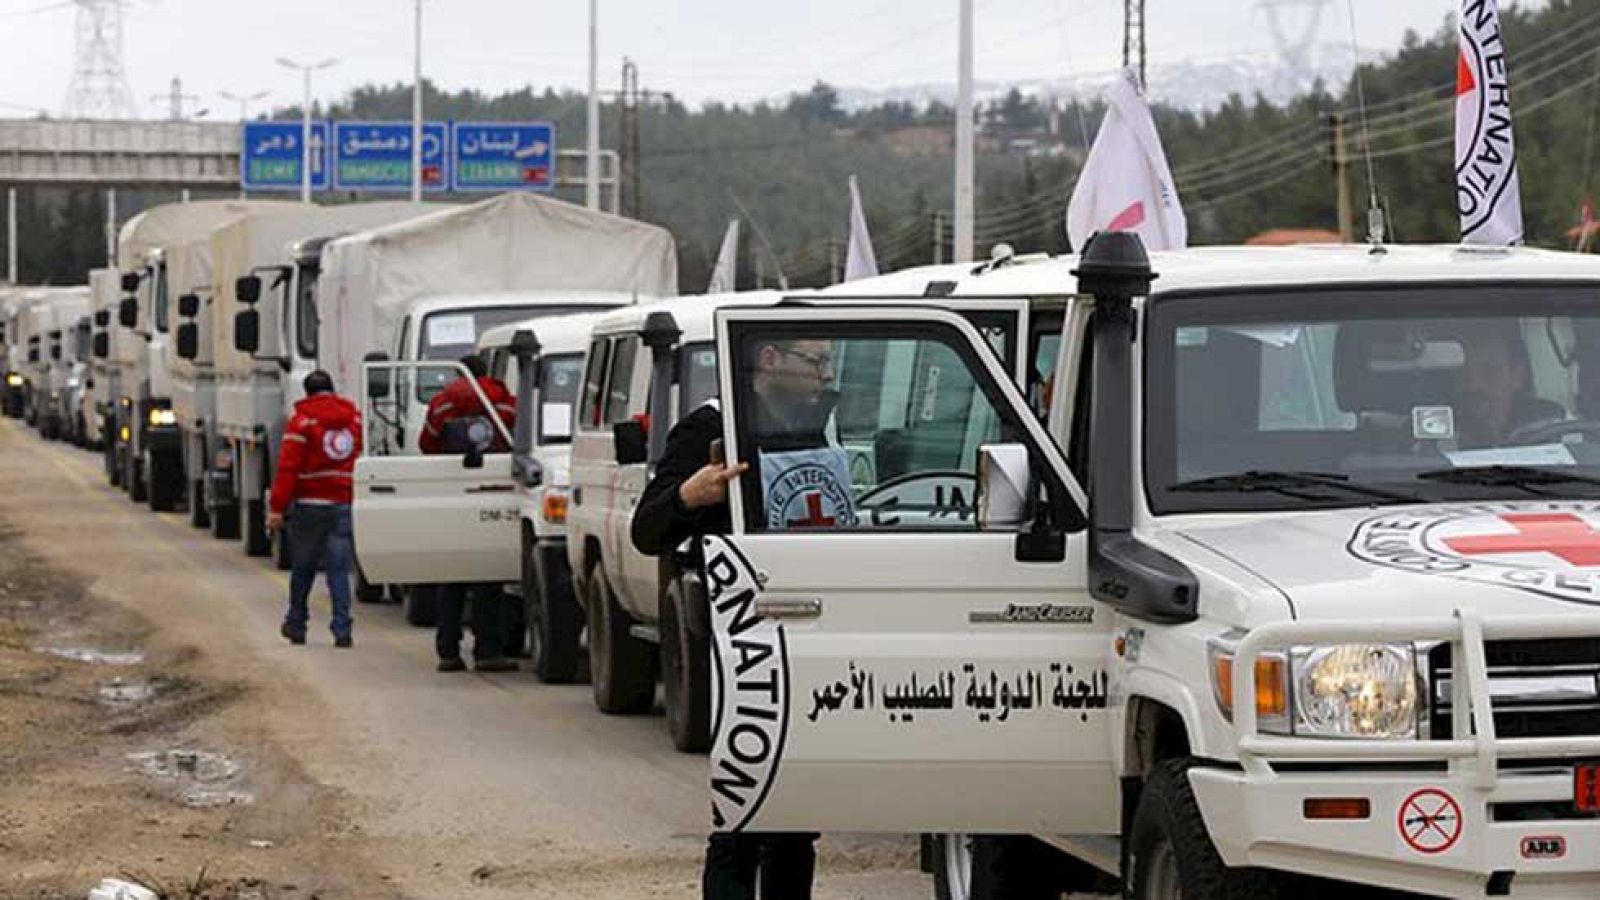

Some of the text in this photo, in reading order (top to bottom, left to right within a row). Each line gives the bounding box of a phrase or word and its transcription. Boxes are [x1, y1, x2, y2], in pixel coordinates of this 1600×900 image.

[1457, 0, 1514, 217] NTERNATIO
[342, 130, 410, 156] دمشق
[461, 130, 520, 156] لبنان
[703, 538, 778, 828] RNATION
[807, 660, 875, 723] الأحمر
[882, 670, 956, 723] للصليب
[963, 662, 1043, 723] الدولية
